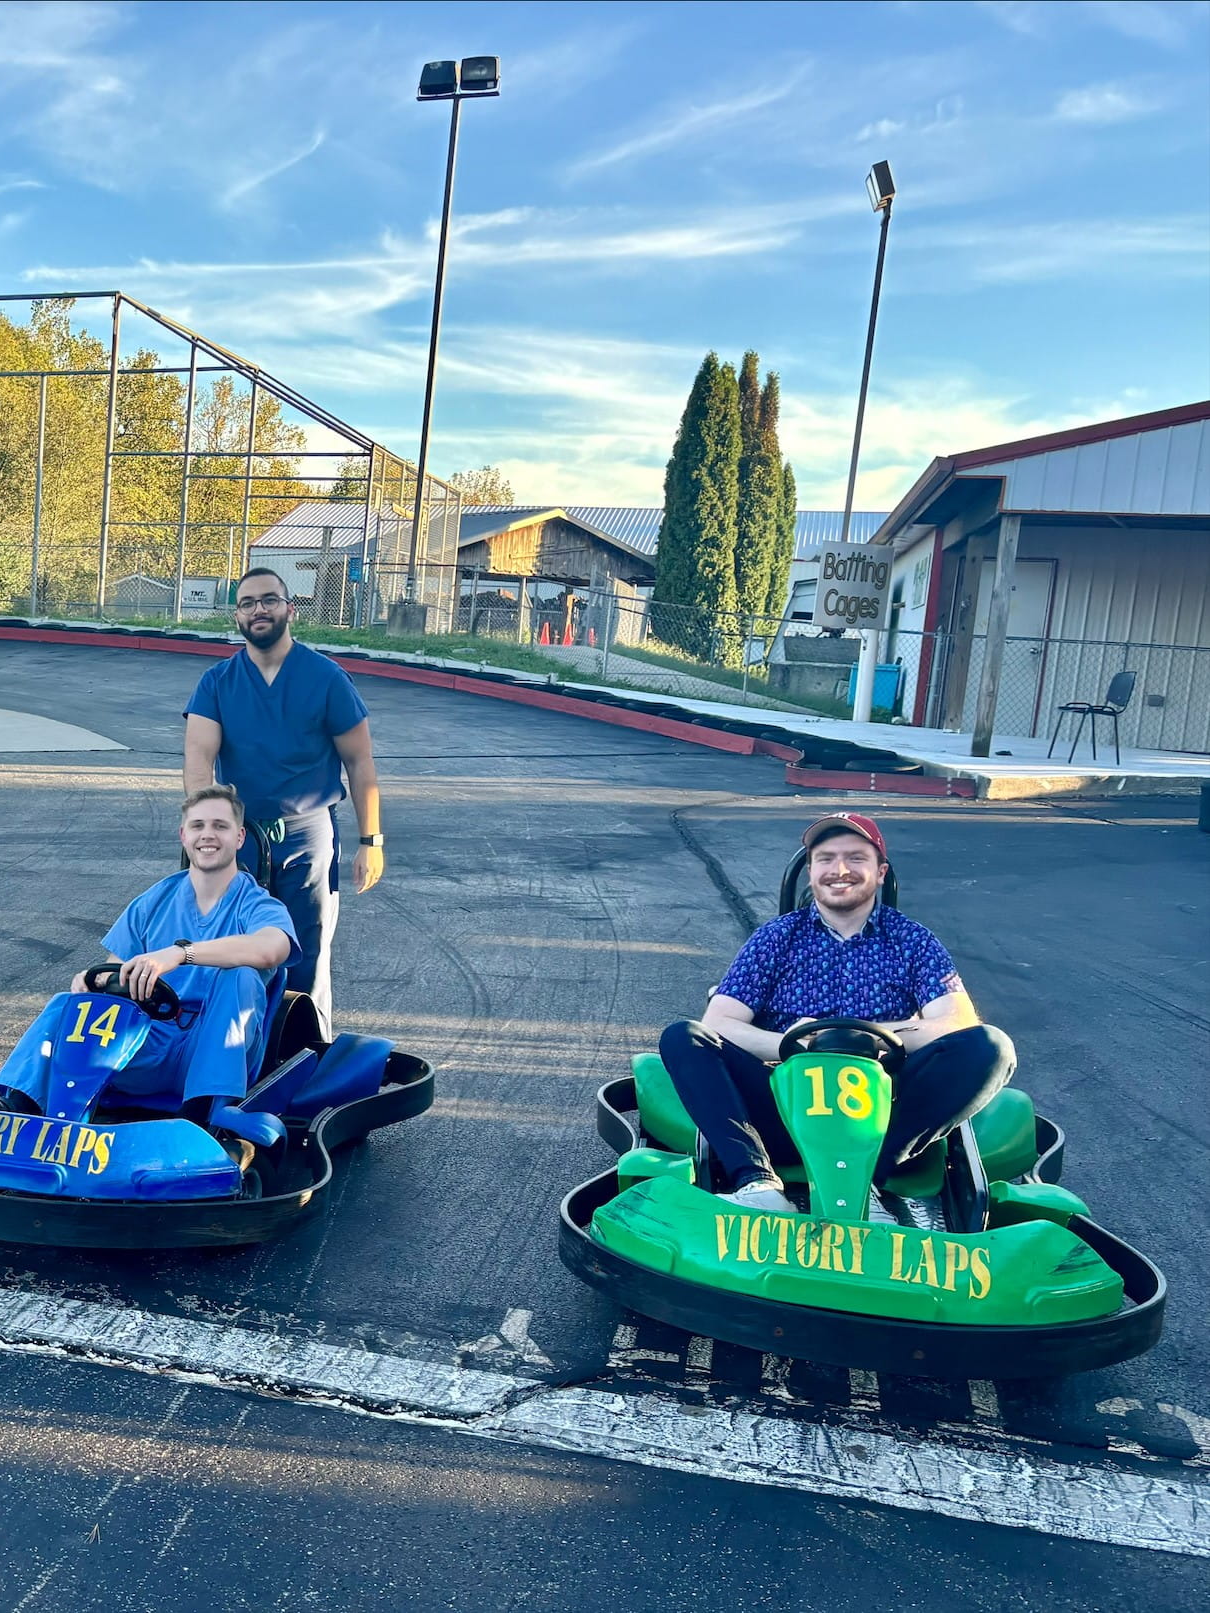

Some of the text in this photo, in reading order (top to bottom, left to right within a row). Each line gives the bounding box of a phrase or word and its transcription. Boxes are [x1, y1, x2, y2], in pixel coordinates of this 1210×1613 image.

[823, 552, 889, 590] Batting
[823, 588, 880, 624] Cages
[65, 1001, 122, 1048] 14
[803, 1066, 874, 1119] 18
[30, 1121, 116, 1175] LAPS
[713, 1213, 993, 1300] VICTORY LAPS
